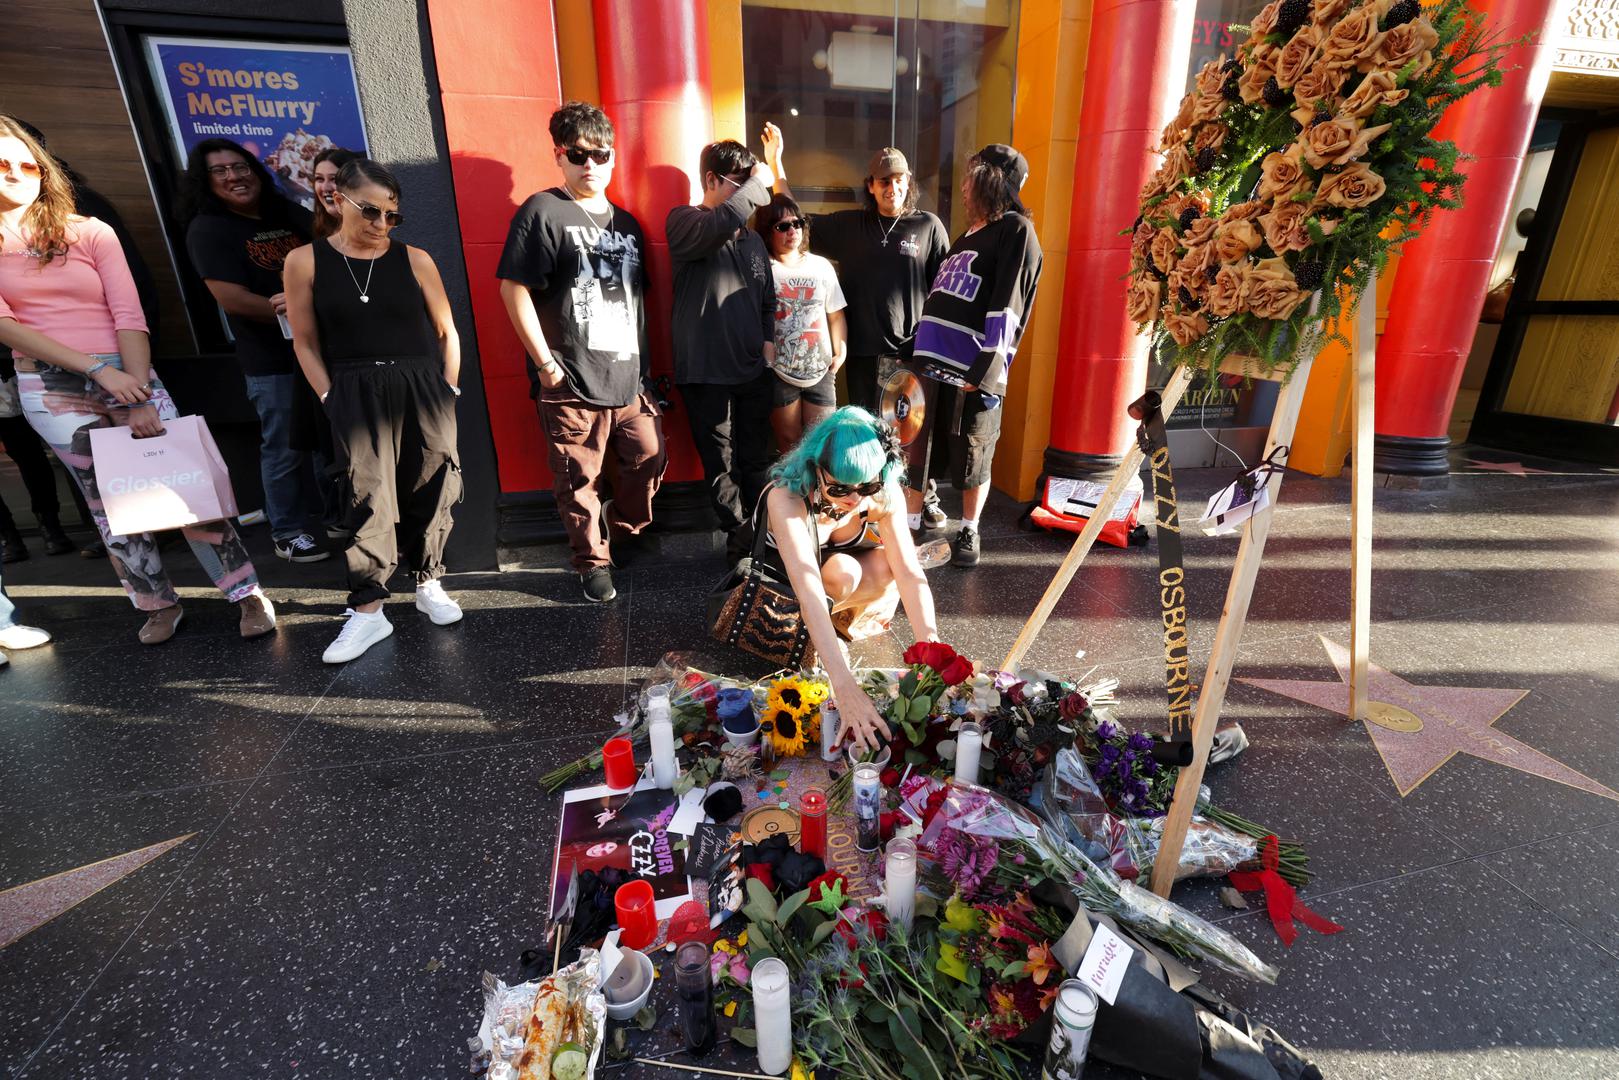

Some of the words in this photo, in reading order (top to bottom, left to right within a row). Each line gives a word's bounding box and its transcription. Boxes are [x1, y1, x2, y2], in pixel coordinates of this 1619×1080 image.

[1192, 20, 1233, 47] EY'S
[178, 62, 299, 90] S'mores
[193, 122, 240, 135] limited
[242, 124, 273, 136] time
[565, 225, 638, 250] TUPAC
[1178, 388, 1241, 407] ARILYN
[106, 470, 206, 496] Glossier.
[1151, 447, 1181, 533] OZZY
[1160, 566, 1192, 737] OSBOURNE
[628, 829, 657, 877] OZZY
[654, 828, 675, 876] OREVER
